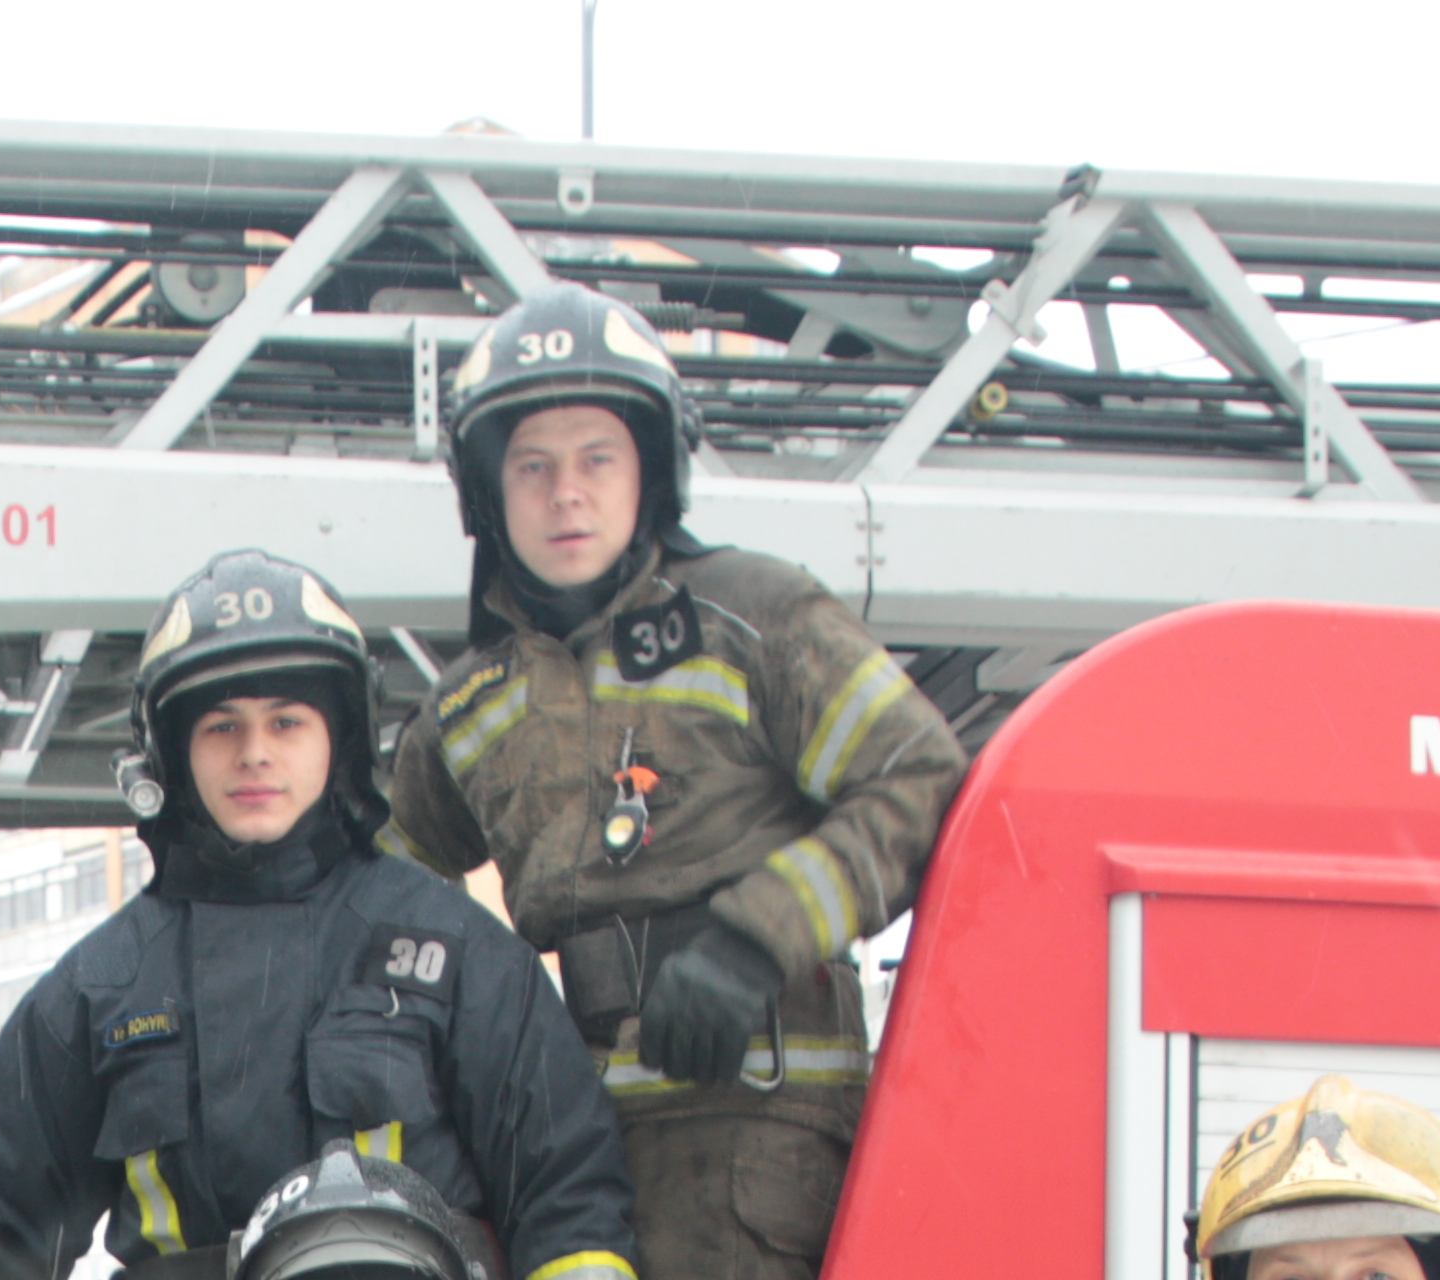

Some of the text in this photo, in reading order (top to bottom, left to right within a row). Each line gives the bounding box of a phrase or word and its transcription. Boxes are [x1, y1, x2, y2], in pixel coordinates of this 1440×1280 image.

[517, 328, 575, 364] 30
[213, 587, 274, 628] 30
[631, 609, 685, 665] 30
[385, 938, 446, 984] 30
